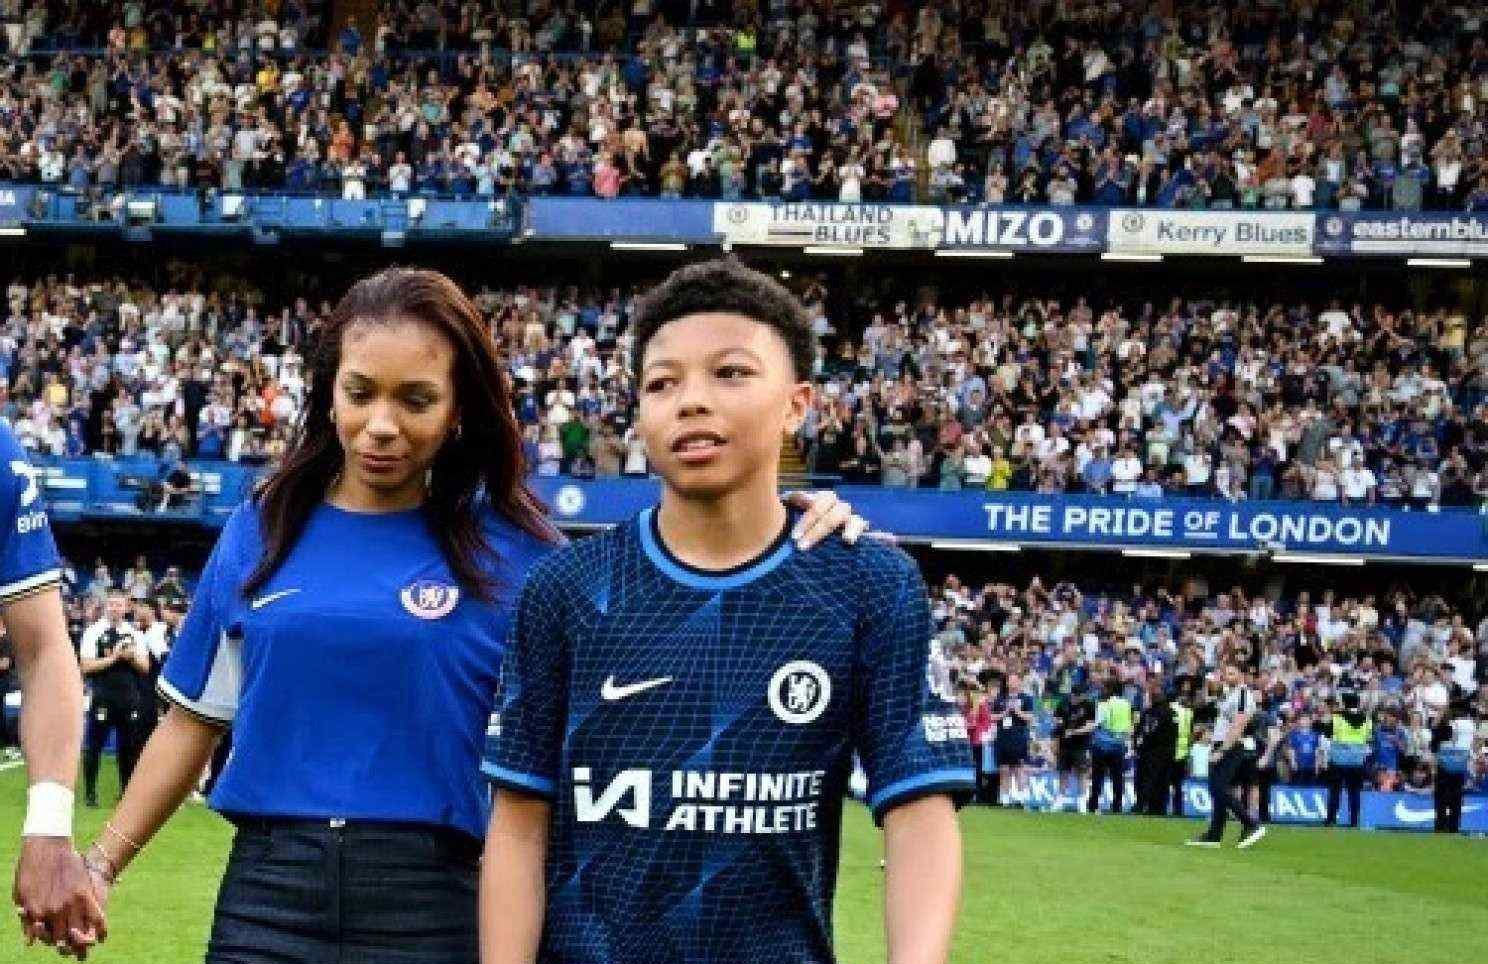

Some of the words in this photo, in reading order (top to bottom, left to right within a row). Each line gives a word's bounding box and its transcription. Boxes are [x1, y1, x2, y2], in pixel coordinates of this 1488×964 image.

[769, 204, 894, 225] THAILAND
[945, 210, 1064, 245] MIZO
[813, 225, 892, 244] BLUES
[1157, 219, 1227, 247] Kerry
[1235, 221, 1308, 243] Blues
[984, 503, 1052, 533] THE
[1062, 505, 1174, 536] PRIDE
[1184, 511, 1221, 532] OF
[1228, 511, 1390, 546] LONDON
[671, 769, 825, 802] INFINITE
[665, 801, 817, 834] ATHLETE
